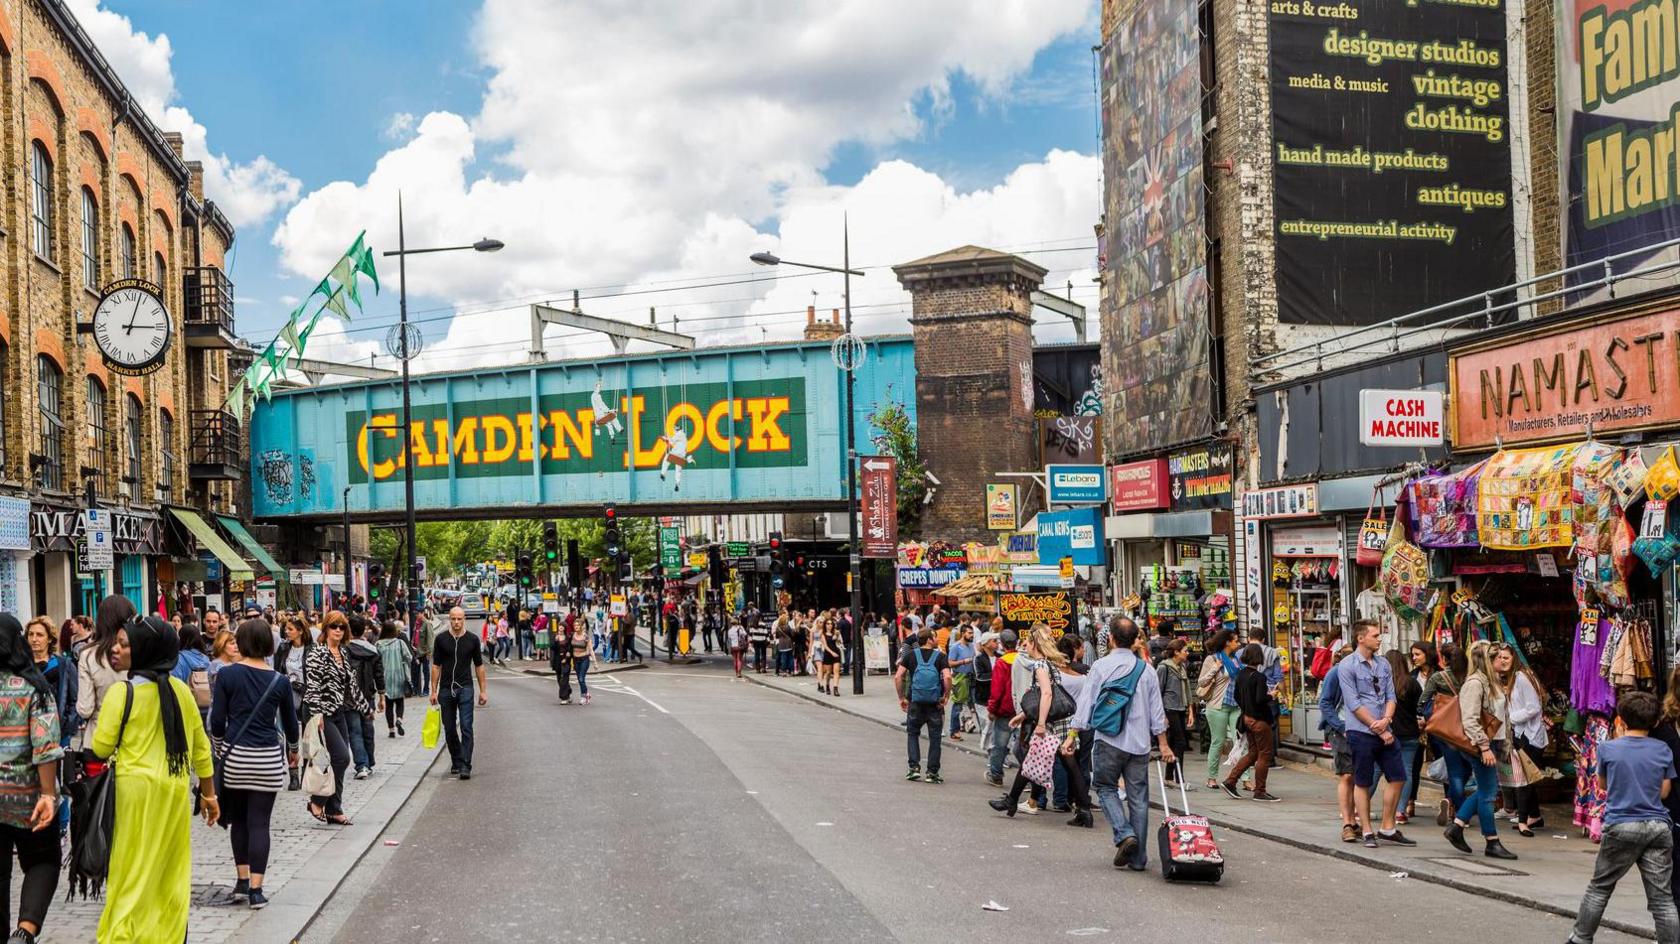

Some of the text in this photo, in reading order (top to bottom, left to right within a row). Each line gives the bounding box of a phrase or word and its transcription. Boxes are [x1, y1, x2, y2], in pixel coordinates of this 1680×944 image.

[1271, 1, 1358, 19] arts & crafts
[1324, 28, 1500, 66] designer studios
[1583, 0, 1680, 104] Fam
[1289, 74, 1389, 93] media & music
[1413, 70, 1500, 104] vintage
[1406, 104, 1502, 139] clothing
[1278, 144, 1448, 172] hand made products
[1418, 185, 1505, 211] antiques
[1281, 220, 1456, 243] entrepreneurial activity
[104, 280, 161, 296] CAMDEN LOCK
[106, 361, 162, 375] MARKET HALL
[1480, 330, 1680, 420] NAMAST
[1386, 399, 1425, 417] CASH
[1371, 420, 1440, 438] MACHINE
[1508, 416, 1556, 433] Manufacturers,
[1557, 411, 1589, 427] Retailers
[357, 408, 593, 480] CAMDEN
[622, 394, 790, 469] LOCK
[866, 476, 880, 498] Zulu
[1066, 474, 1096, 483] Lebara
[868, 499, 880, 529] Shaka
[1039, 519, 1070, 537] CANAL NEWS
[1364, 520, 1387, 531] SALE
[900, 570, 927, 585] CREPES
[929, 569, 957, 584] DONUTS
